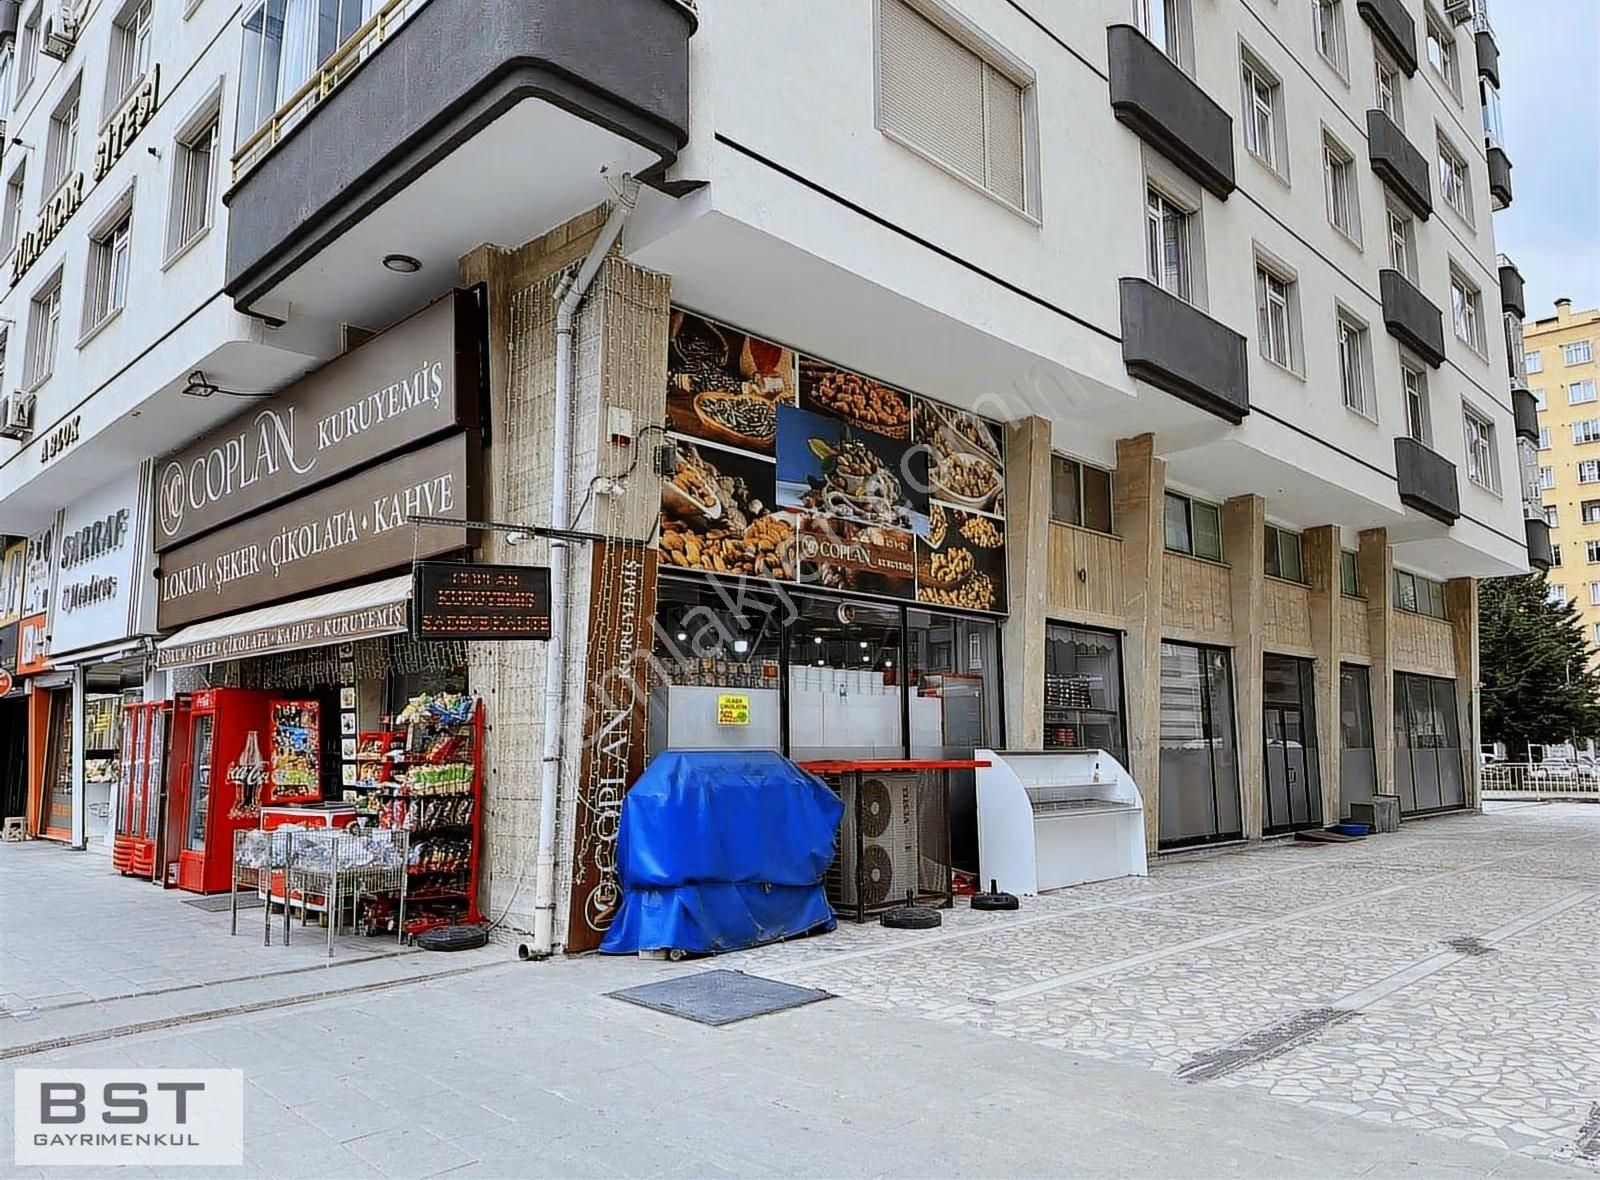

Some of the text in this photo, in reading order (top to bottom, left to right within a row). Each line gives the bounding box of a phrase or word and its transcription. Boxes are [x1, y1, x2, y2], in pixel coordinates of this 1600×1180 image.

[190, 406, 316, 509] COPLAN
[318, 360, 443, 450] KURUYEMİŞ
[61, 508, 130, 569] SARRAF
[163, 474, 454, 601] LOKUM ŞEKER ÇİKOLATA KAHVE
[276, 624, 314, 644] KAHVE
[323, 604, 402, 637] KURUYEMİŞ
